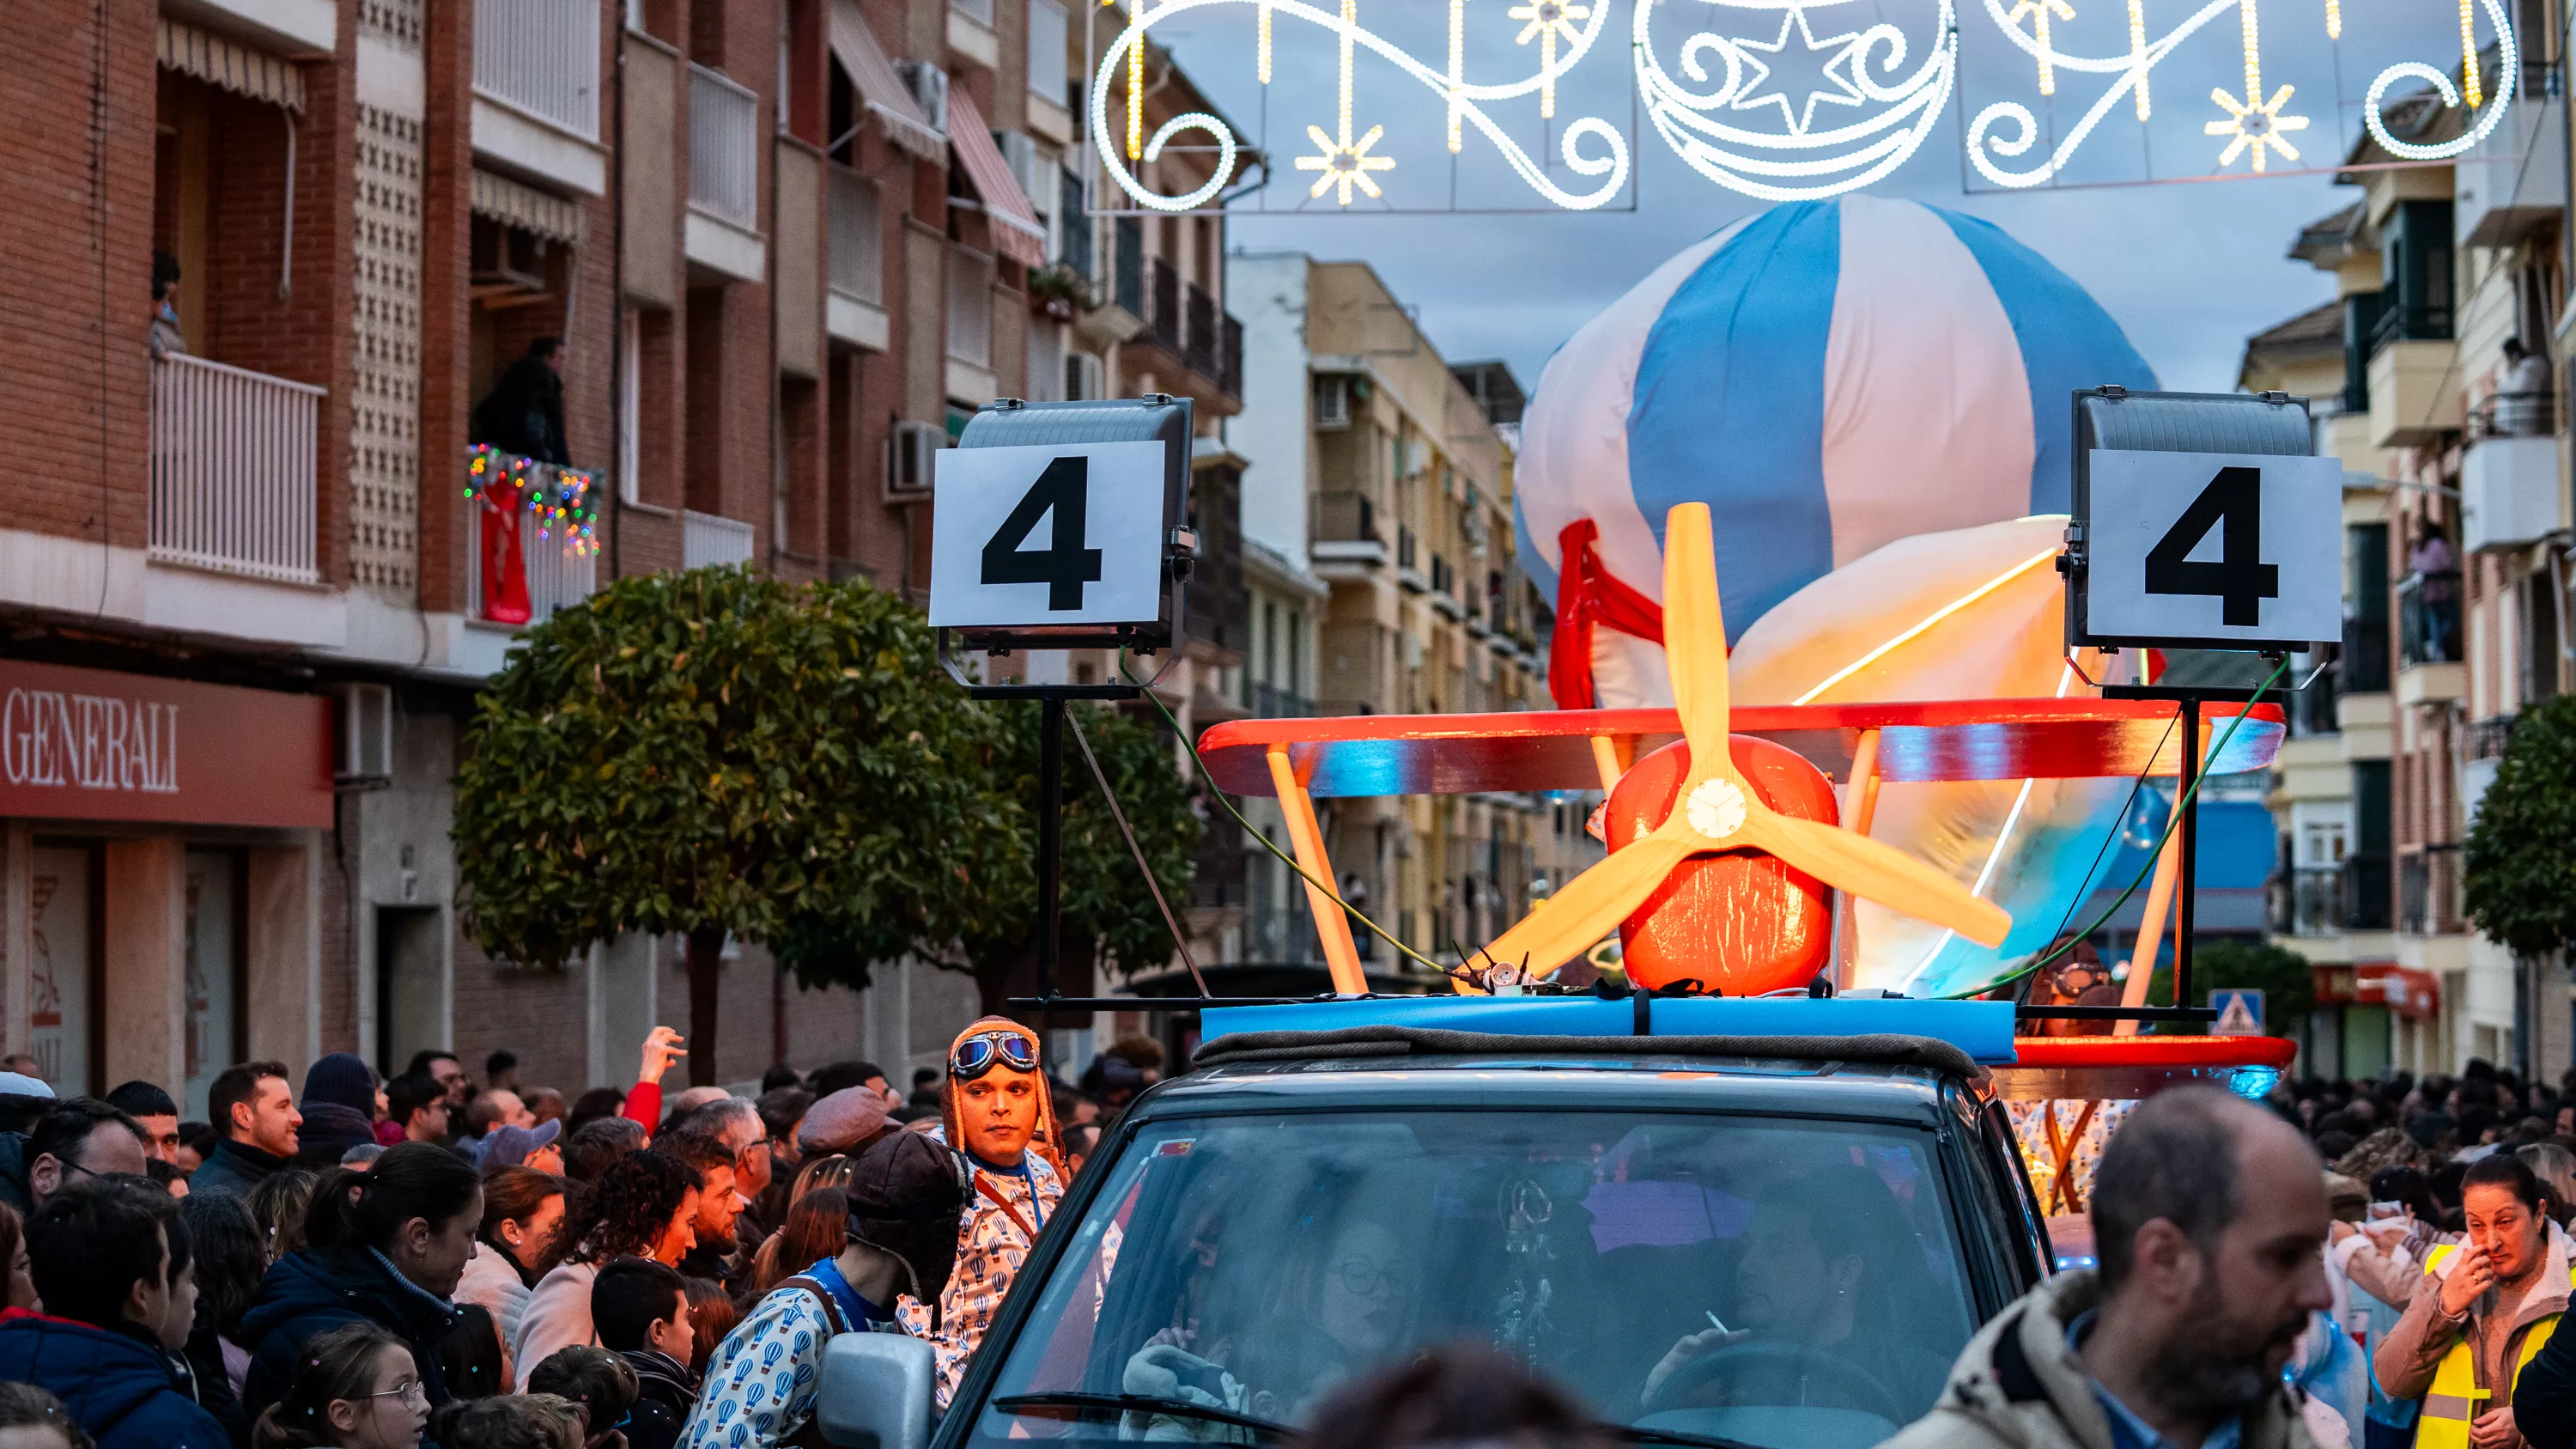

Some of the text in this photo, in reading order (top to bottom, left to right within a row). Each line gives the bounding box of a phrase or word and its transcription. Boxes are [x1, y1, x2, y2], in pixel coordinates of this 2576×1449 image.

[981, 456, 1103, 611] 4
[2145, 466, 2279, 626] 4
[3, 687, 179, 794] GENERALI
